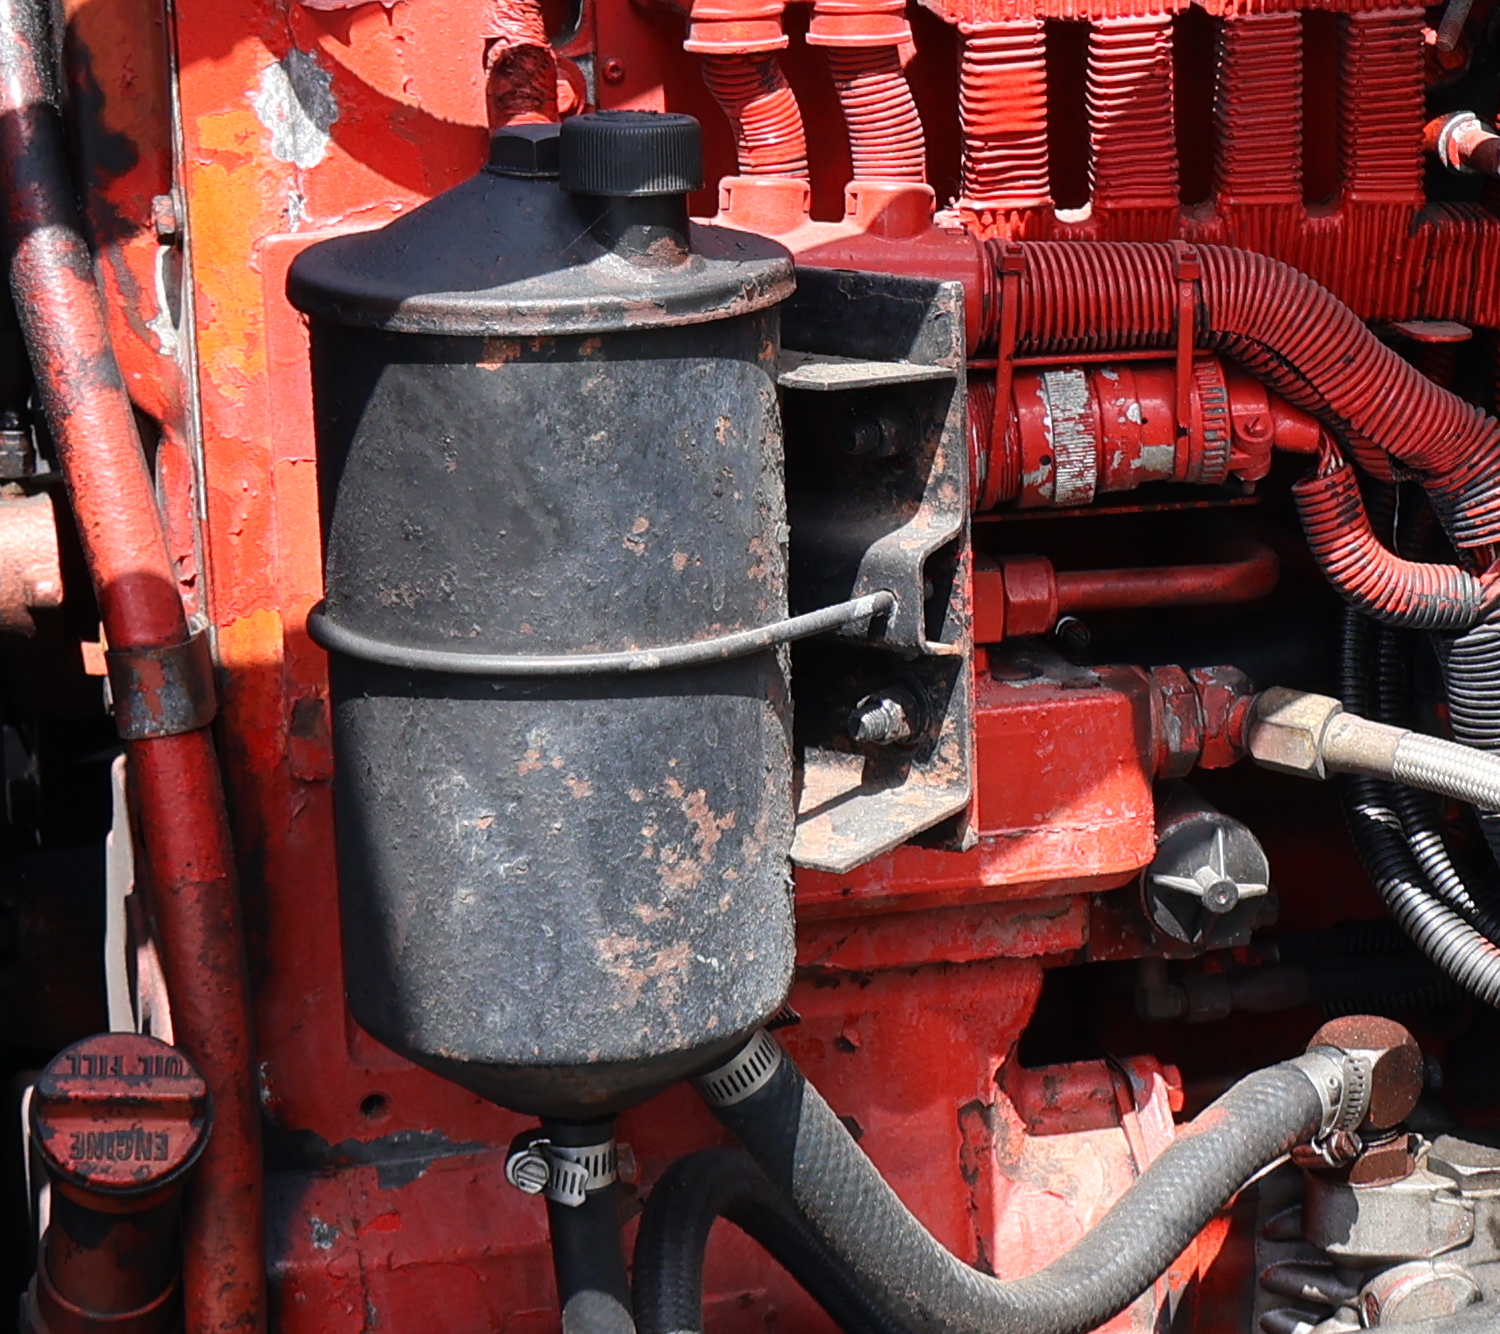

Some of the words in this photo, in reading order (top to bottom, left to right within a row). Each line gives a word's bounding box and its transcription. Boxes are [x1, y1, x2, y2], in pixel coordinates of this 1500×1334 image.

[65, 1054, 124, 1077] FILL
[137, 1054, 183, 1077] OIL
[70, 1130, 170, 1162] ENGINE
